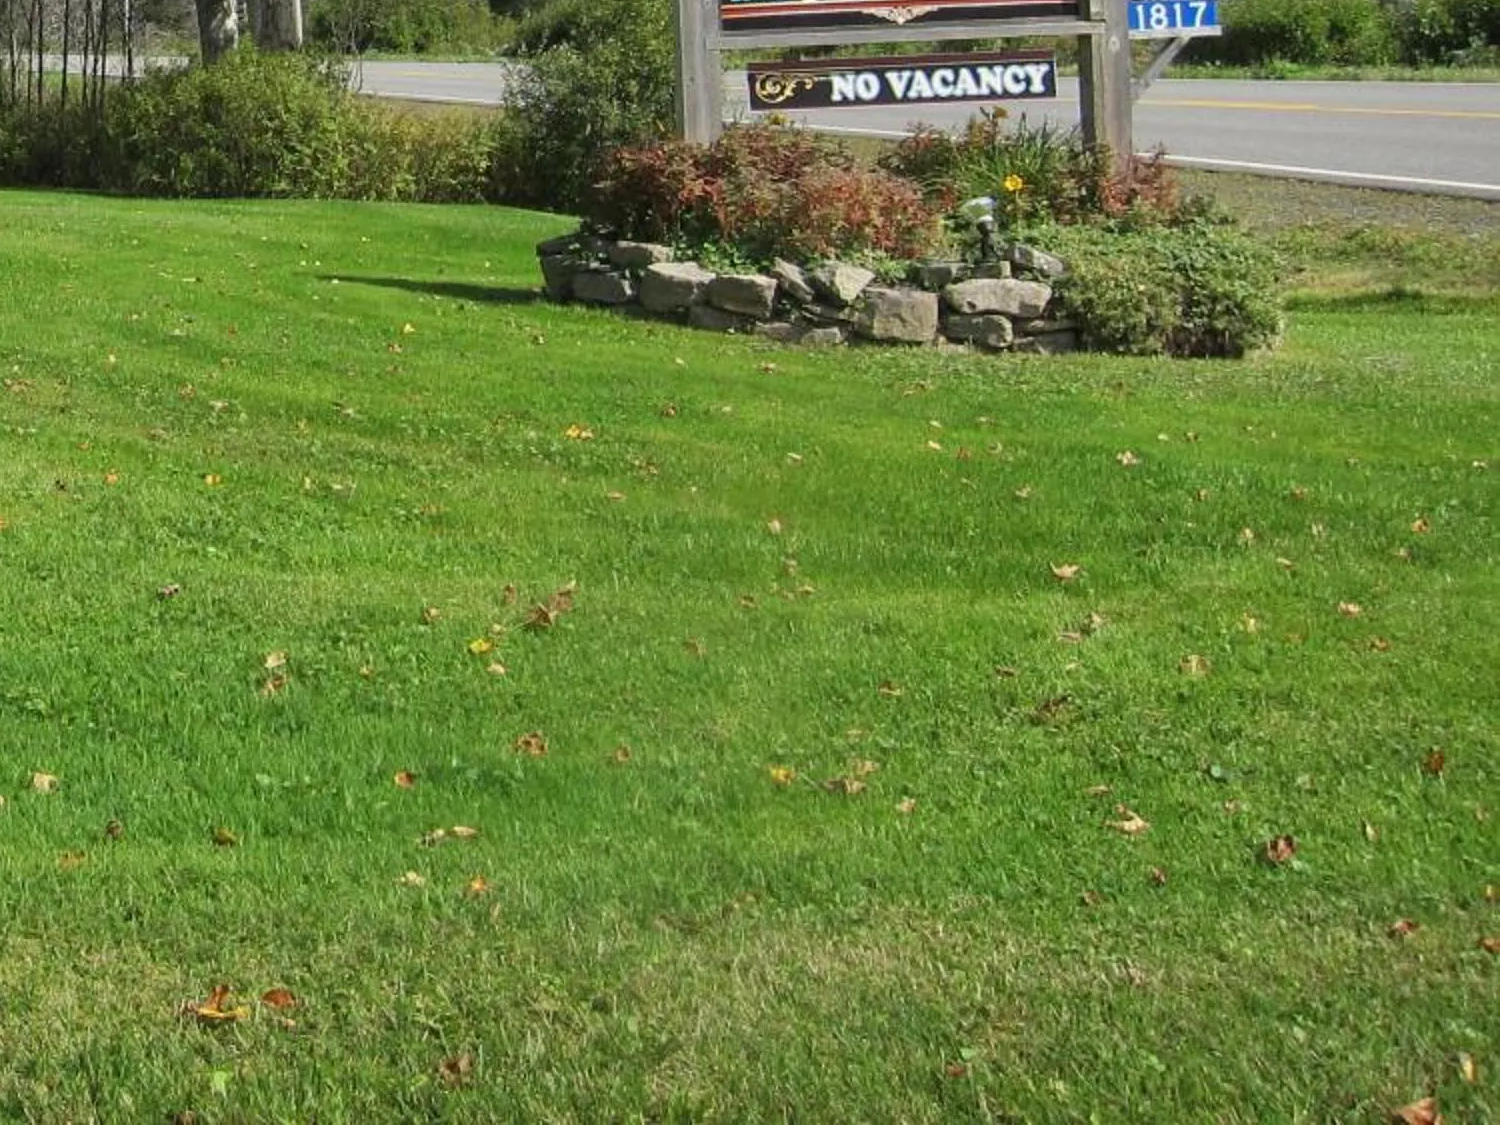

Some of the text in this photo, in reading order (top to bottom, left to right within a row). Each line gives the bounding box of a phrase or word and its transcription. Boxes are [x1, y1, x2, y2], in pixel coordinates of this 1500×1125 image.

[1134, 0, 1207, 30] 1817
[830, 62, 1050, 102] NO VACANCY
